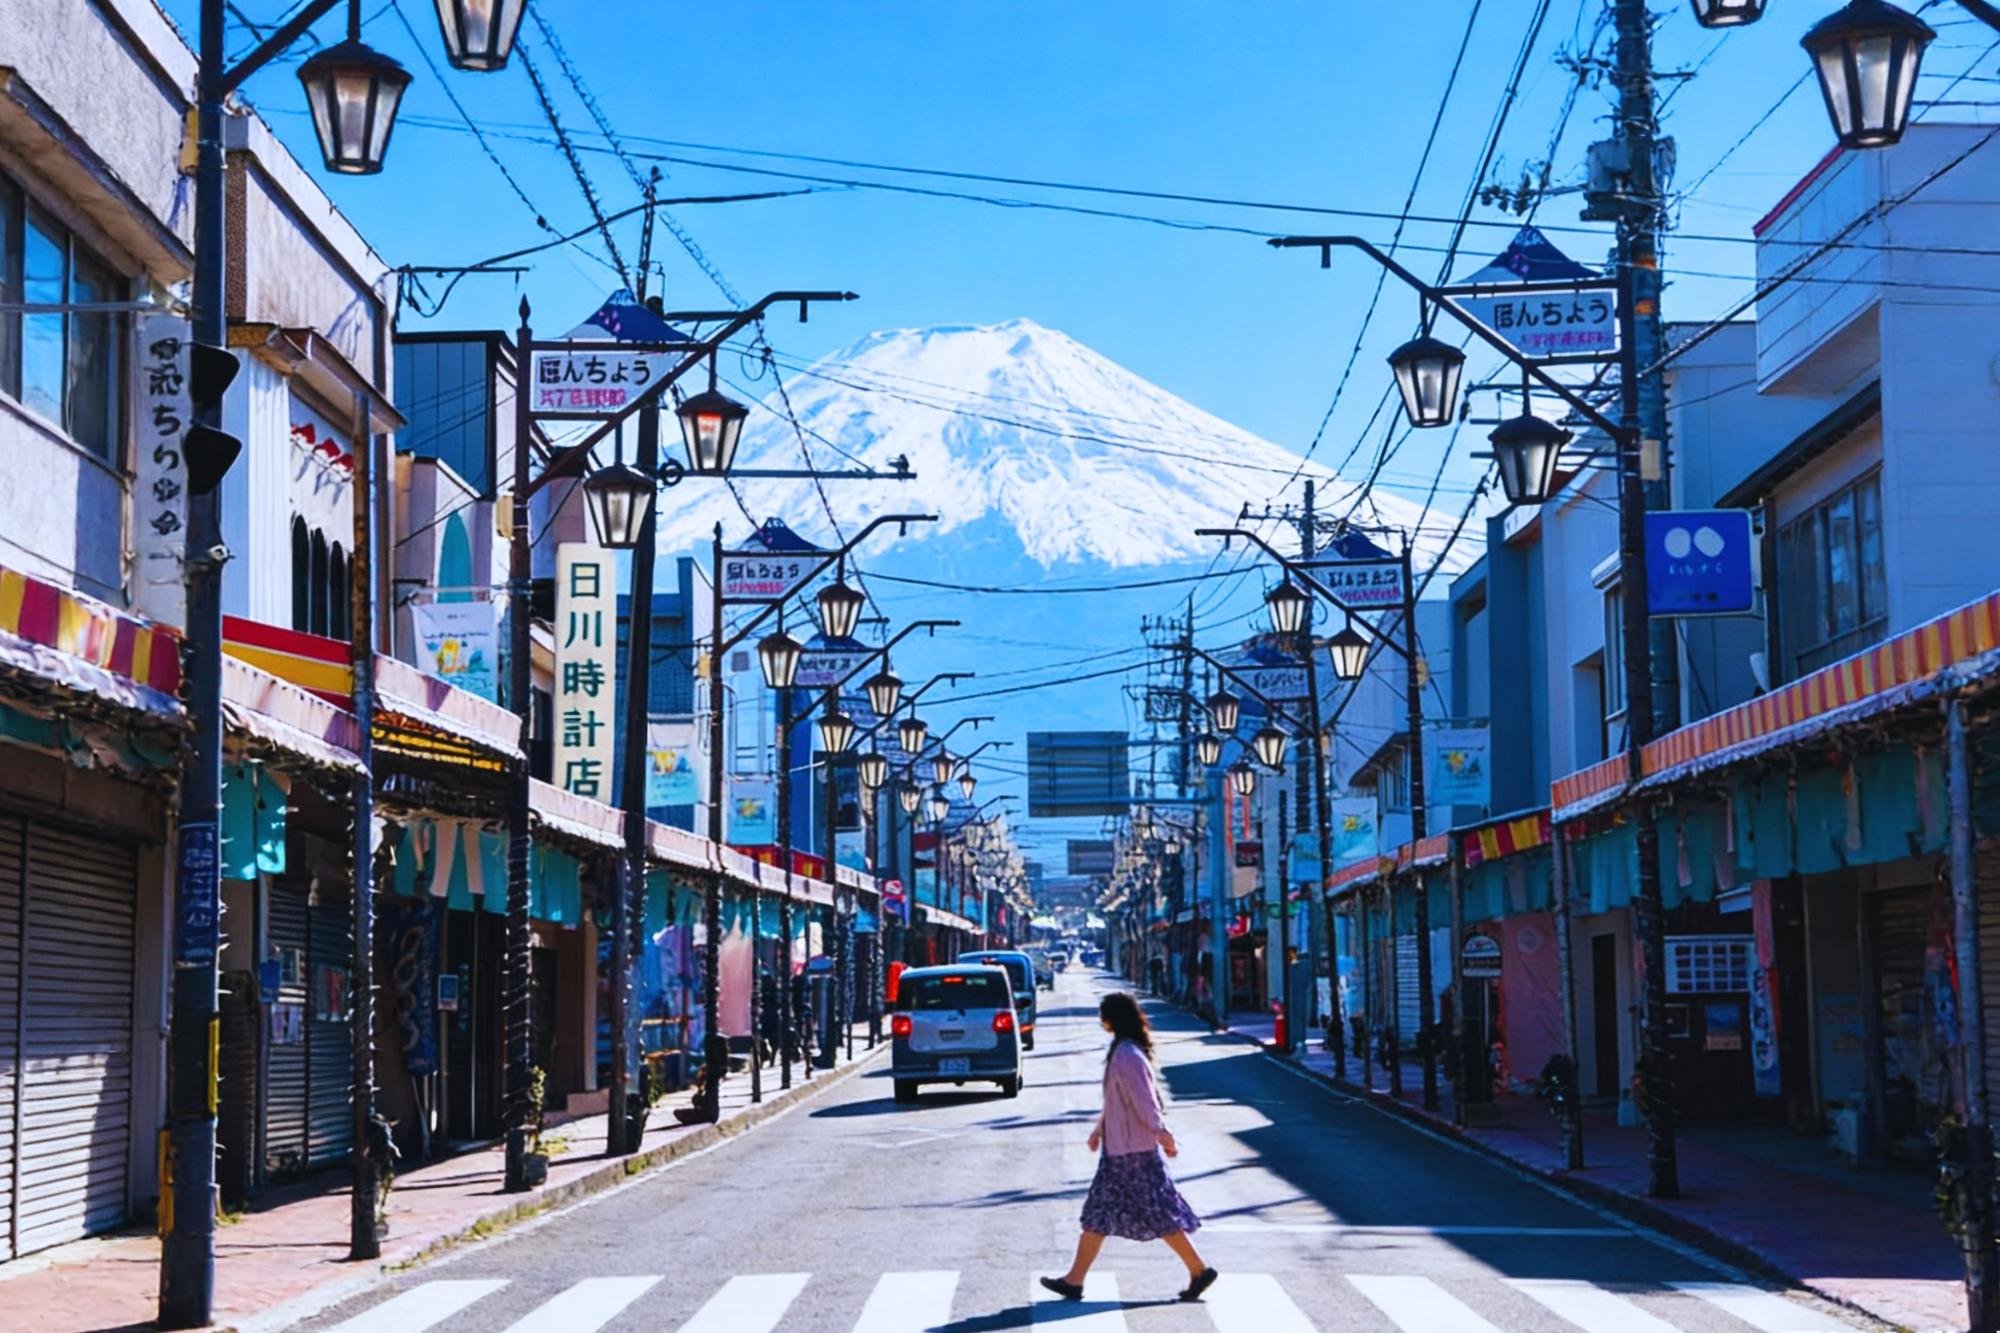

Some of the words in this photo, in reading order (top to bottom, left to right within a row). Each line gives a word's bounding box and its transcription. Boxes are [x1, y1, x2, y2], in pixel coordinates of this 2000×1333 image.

[563, 562, 605, 798] 日川時計店
